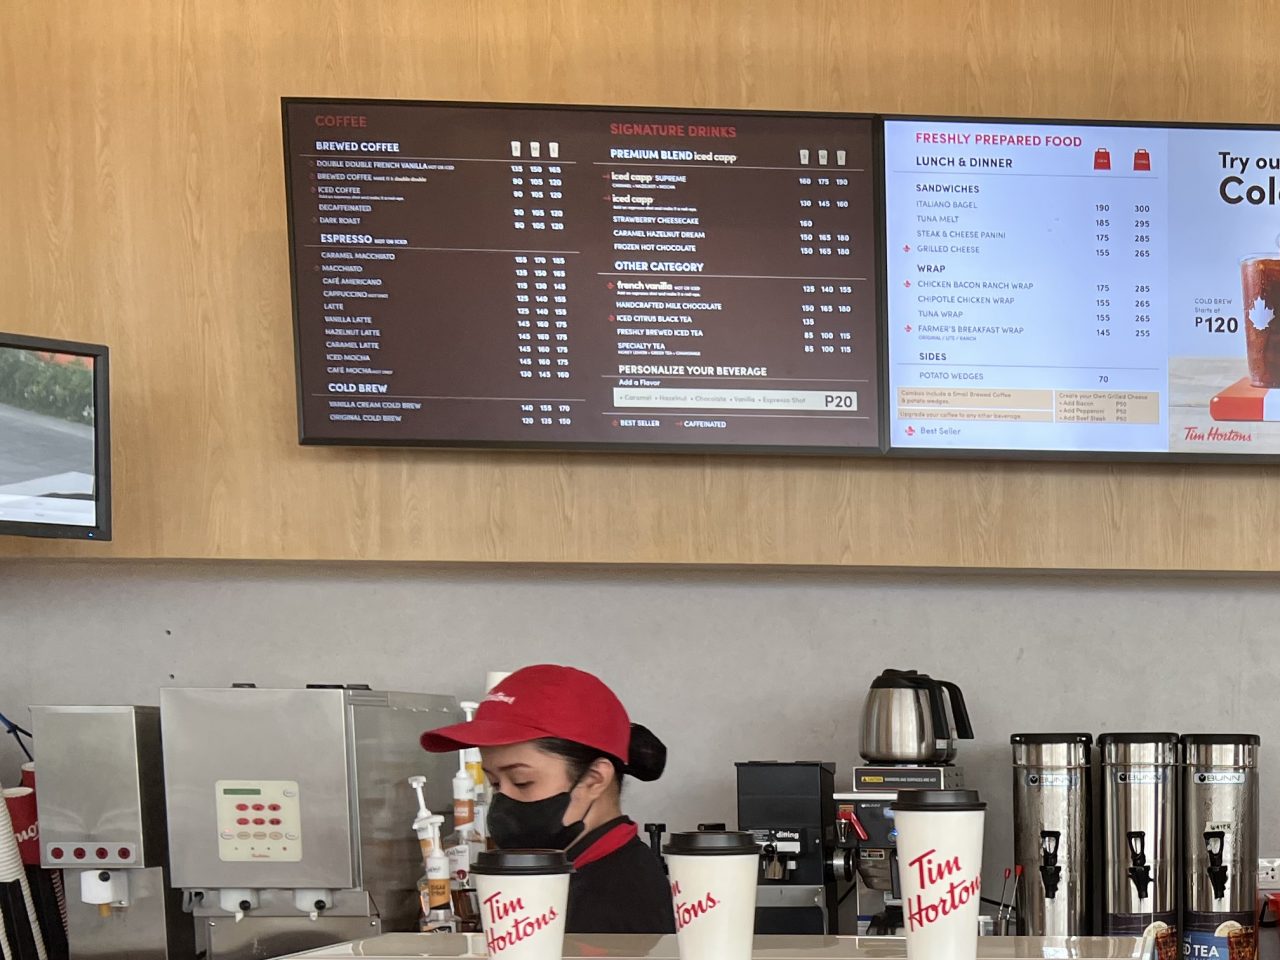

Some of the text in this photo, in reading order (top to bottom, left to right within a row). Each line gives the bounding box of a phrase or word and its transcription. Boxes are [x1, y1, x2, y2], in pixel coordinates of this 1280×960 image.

[315, 115, 367, 127] COFFEE
[610, 124, 736, 138] SIGNATURE DRINKS
[916, 133, 1082, 147] FRESHLY PREPARED FOOD
[316, 142, 399, 152] BREWED COFFEE
[611, 149, 736, 163] PREMIUM BLEND iced capp
[916, 156, 1013, 168] LUNCH & DINNER
[1219, 152, 1249, 173] Try
[916, 184, 979, 193] SANDWICHES
[612, 194, 653, 205] iced capp
[1096, 204, 1149, 213] 190 300
[321, 234, 372, 244] ESPRESSO
[1135, 235, 1150, 243] 285
[917, 245, 949, 253] GRILLED
[615, 261, 704, 272] OTHER CATEGORY
[917, 264, 945, 273] WRAP
[617, 282, 672, 290] french vanilla
[954, 281, 980, 289] BACON
[1011, 282, 1033, 290] WRAP
[1195, 317, 1238, 333] P120
[919, 352, 946, 361] SIDES
[619, 365, 767, 376] PERSONALIZE YOUR BEVERAGE
[329, 383, 387, 393] COLD BREW
[825, 395, 853, 408] P20
[921, 427, 960, 435] Best Seller
[1184, 427, 1252, 441] Tim Hortons
[1206, 774, 1240, 783] BUNN
[908, 849, 962, 890] Tim
[483, 891, 525, 924] Tim
[675, 891, 717, 932] tons
[485, 906, 557, 957] Hortons
[1193, 944, 1220, 957] TEA
